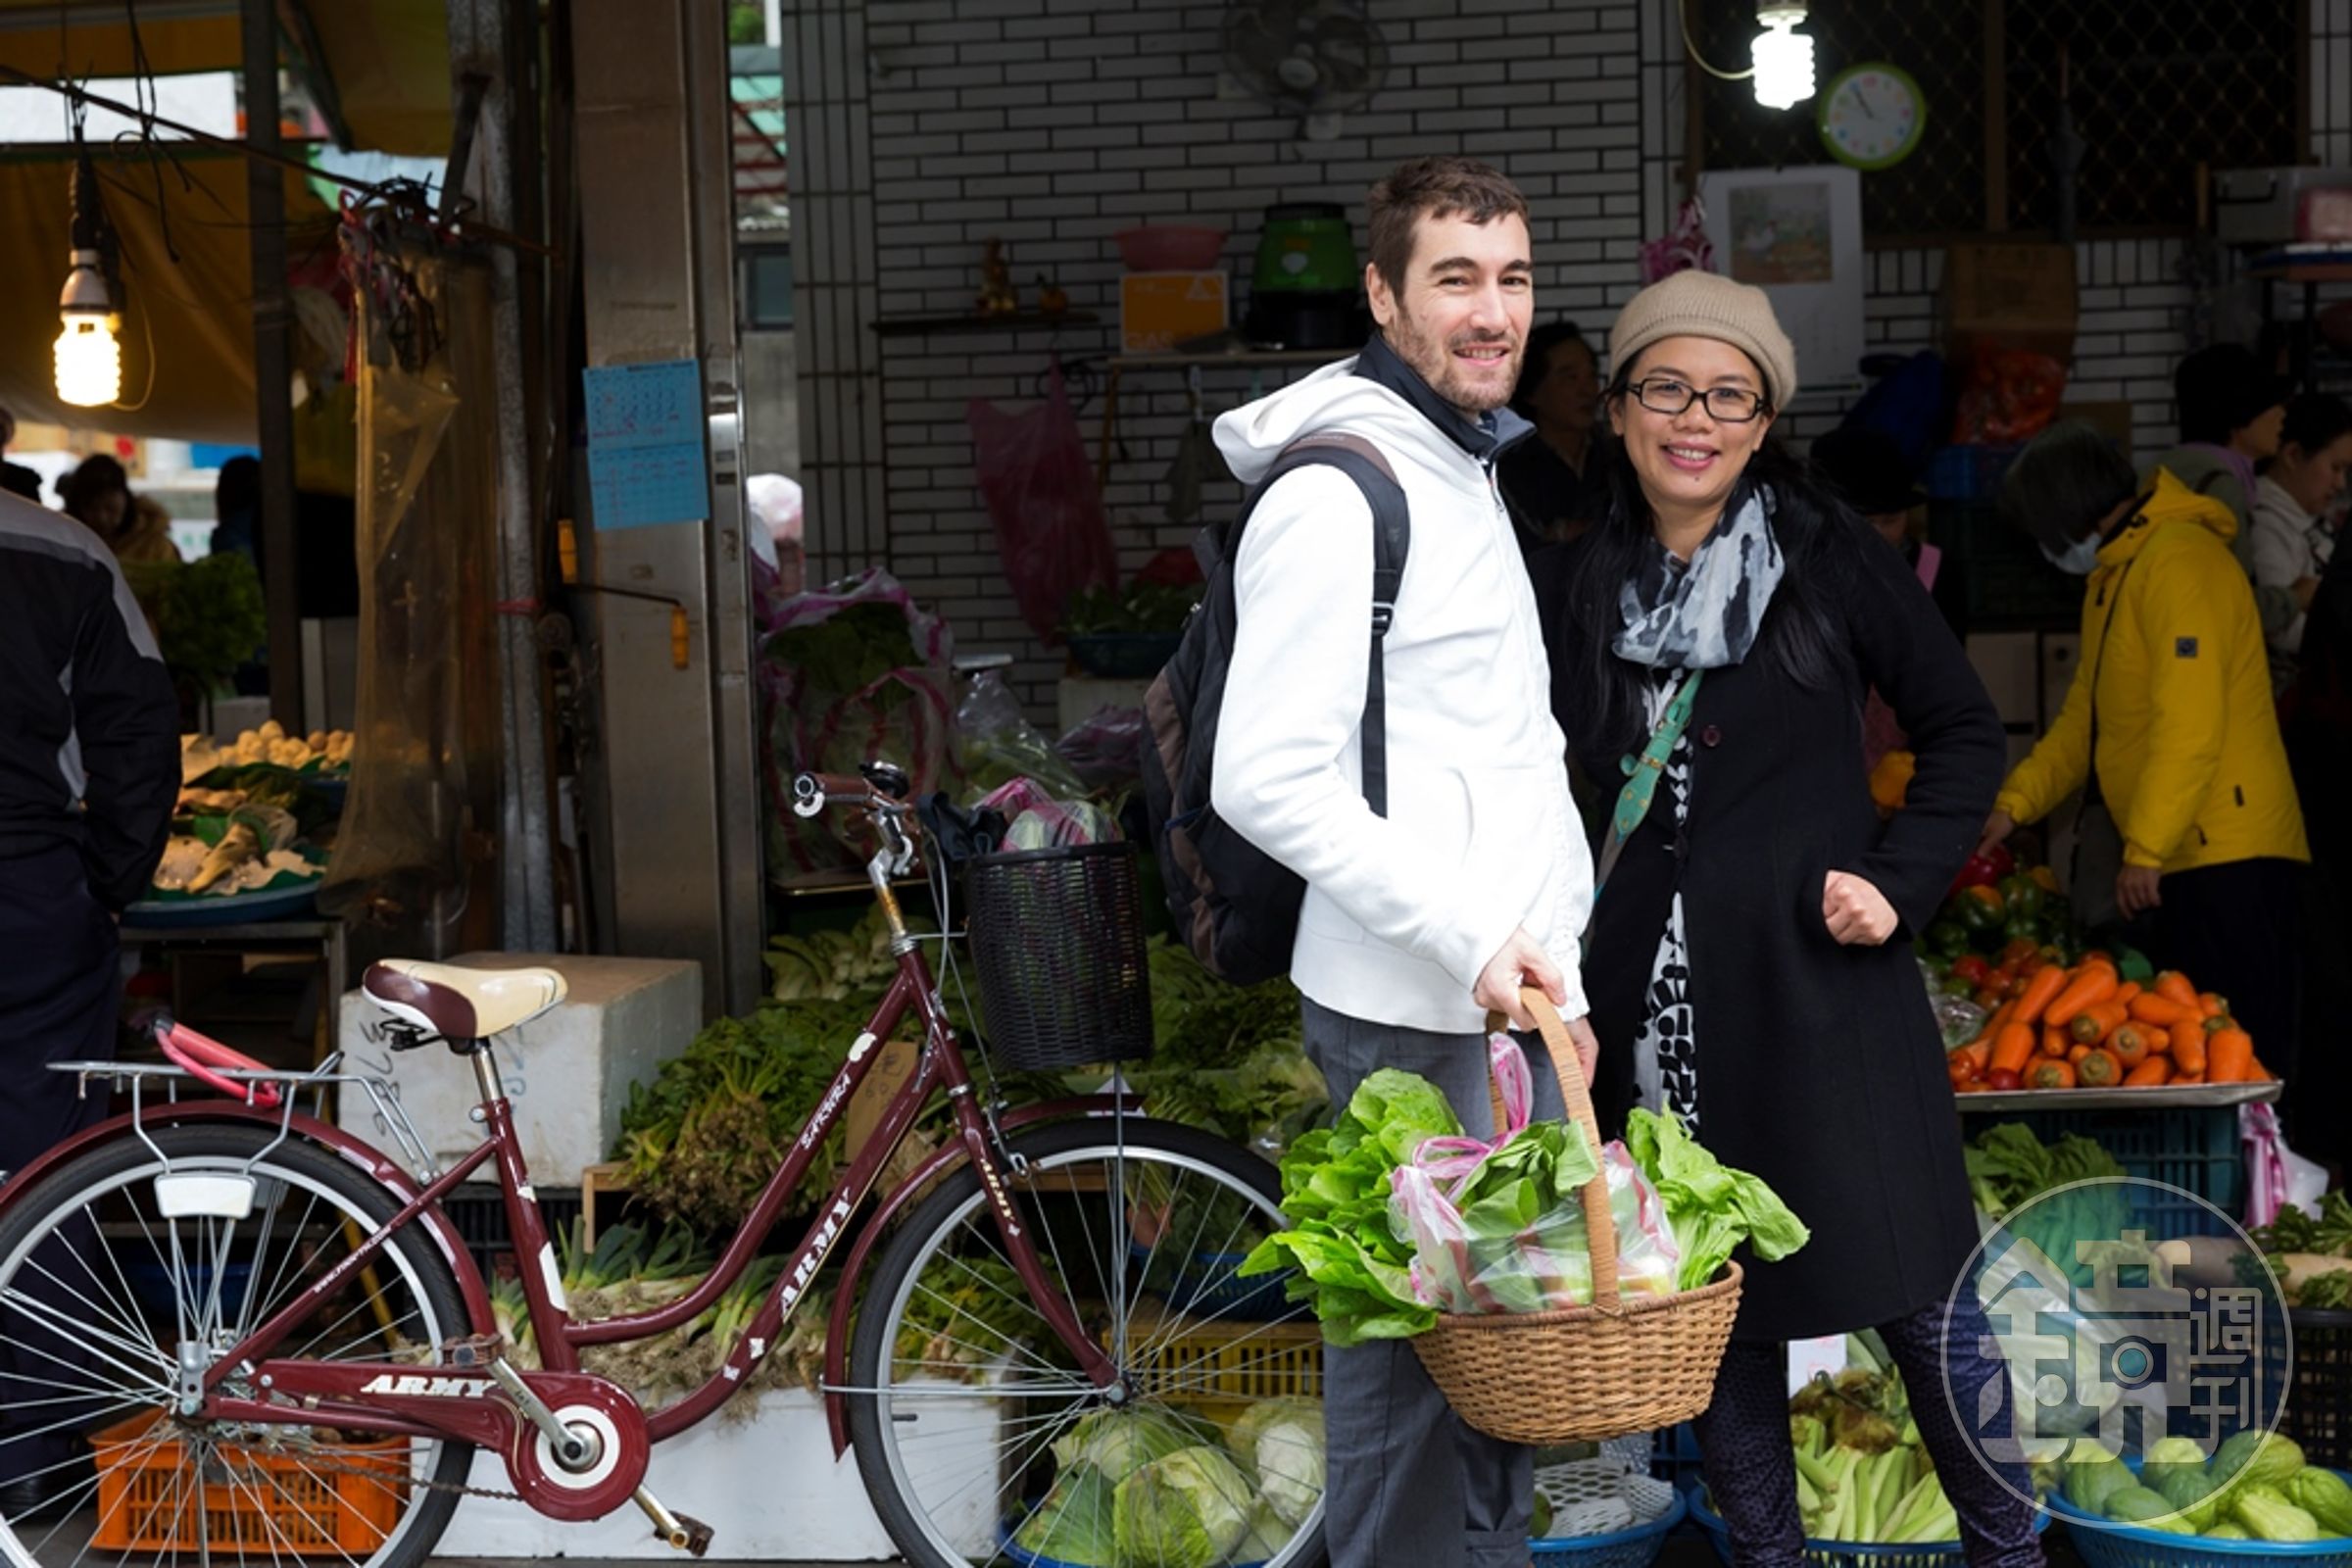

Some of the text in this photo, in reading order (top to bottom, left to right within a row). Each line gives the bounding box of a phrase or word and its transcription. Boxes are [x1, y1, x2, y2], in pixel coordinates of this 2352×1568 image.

[981, 1158, 1016, 1222] ARMY
[781, 1186, 852, 1320] ARMY
[360, 1374, 498, 1397] ARMY
